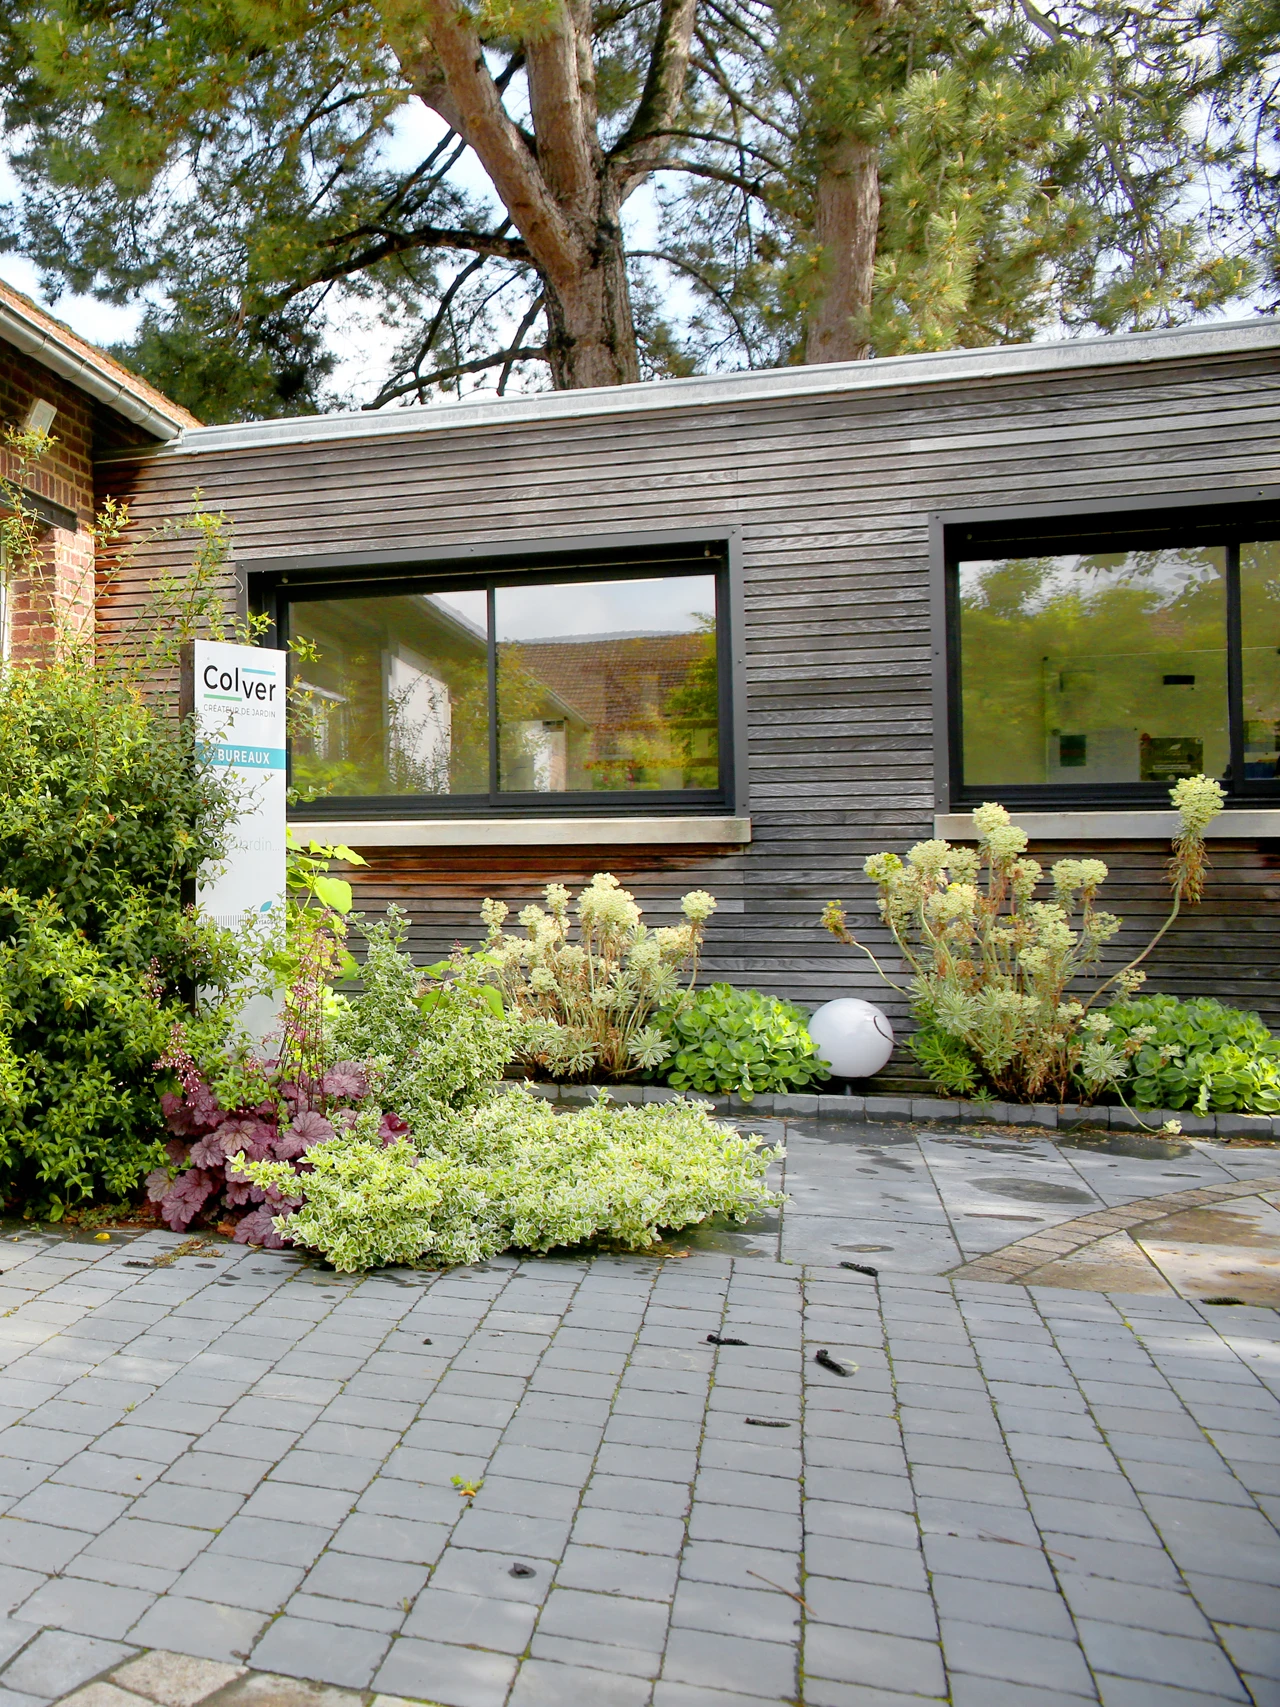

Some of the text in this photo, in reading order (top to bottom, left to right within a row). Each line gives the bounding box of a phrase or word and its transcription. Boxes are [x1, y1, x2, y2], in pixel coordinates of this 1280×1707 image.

[203, 664, 276, 701] Colver
[203, 703, 276, 718] CRÉATEUR DE JARDIN
[217, 748, 270, 765] BUREAUX
